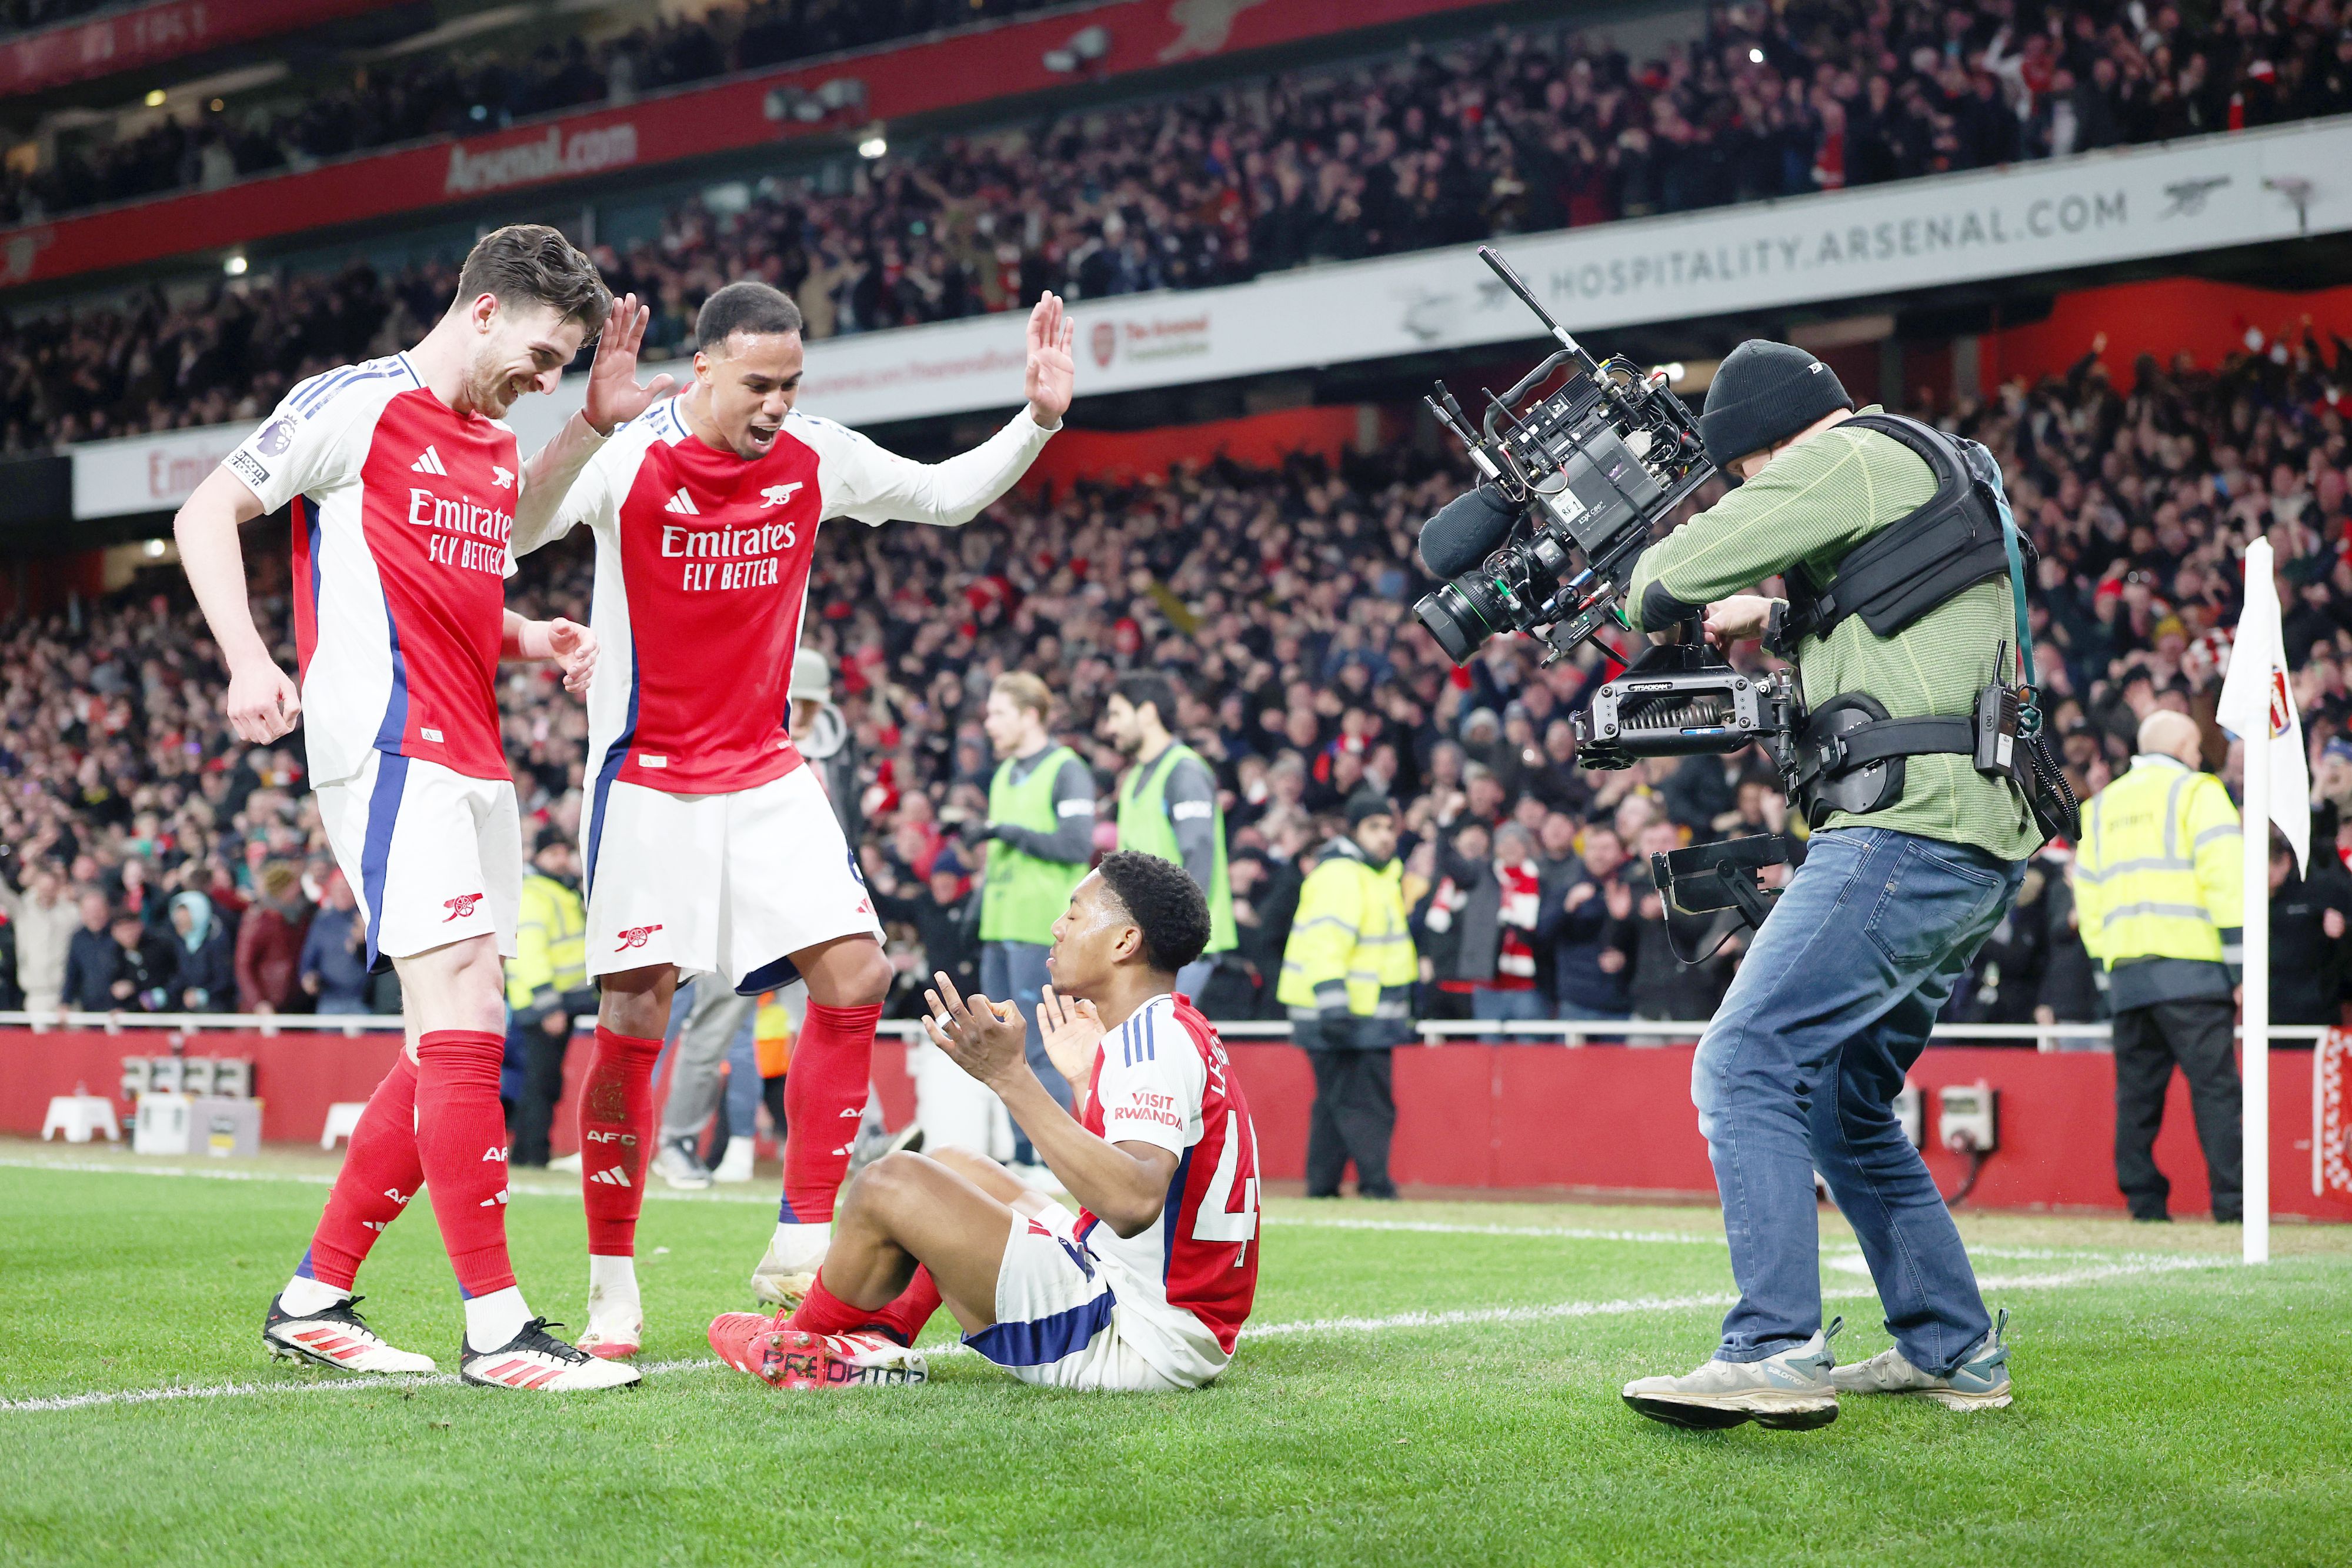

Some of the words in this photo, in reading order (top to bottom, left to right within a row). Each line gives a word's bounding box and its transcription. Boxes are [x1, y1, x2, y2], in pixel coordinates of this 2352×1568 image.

[444, 122, 638, 194] Arsenal.com
[1549, 191, 2128, 299] HOSPITALITY.ARSENAL.COM
[408, 488, 513, 543] Emirate
[1562, 505, 1572, 516] RF
[1573, 501, 1581, 511] 1
[428, 533, 459, 565] FLY
[461, 540, 504, 576] BETTER
[661, 521, 796, 557] Emirates
[683, 563, 716, 590] FLY
[720, 557, 778, 590] BETTER
[1132, 1093, 1174, 1110] VISIT
[1115, 1107, 1183, 1132] RWANDA
[587, 1129, 637, 1146] AFC
[1192, 1109, 1261, 1267] 4
[763, 1350, 925, 1385] PREDATOR
